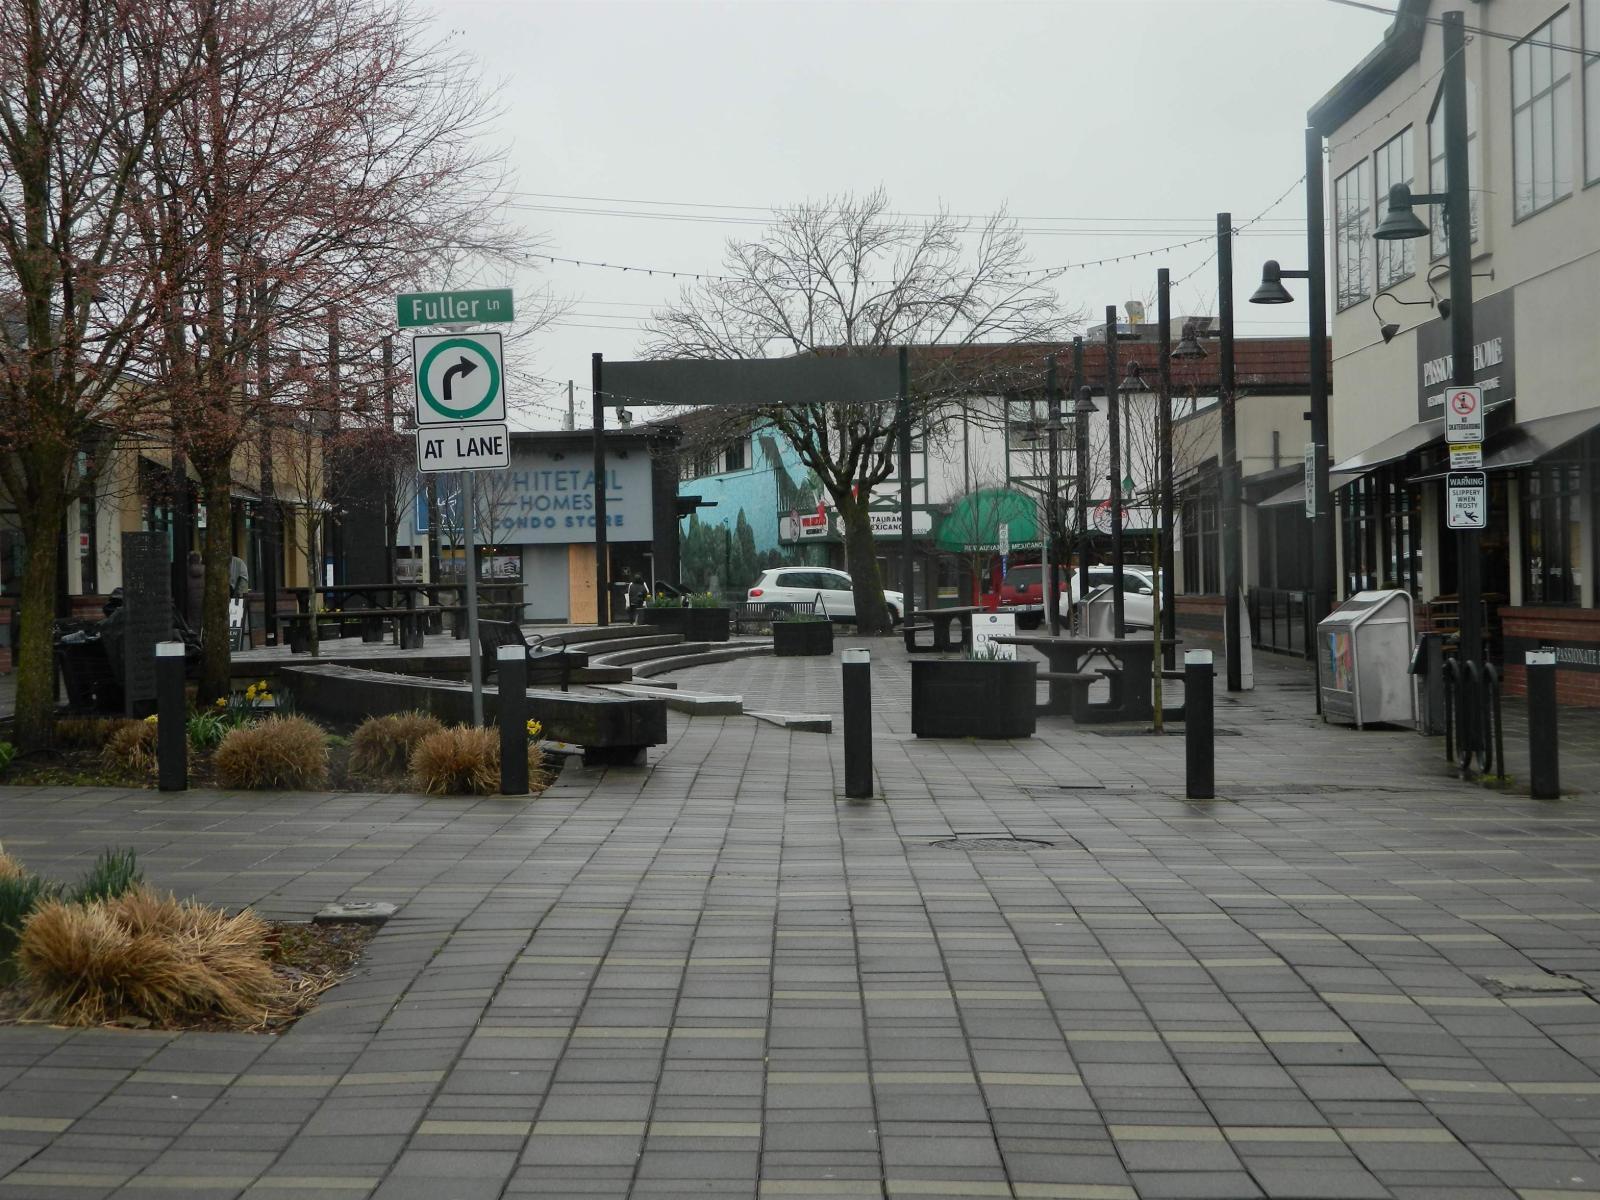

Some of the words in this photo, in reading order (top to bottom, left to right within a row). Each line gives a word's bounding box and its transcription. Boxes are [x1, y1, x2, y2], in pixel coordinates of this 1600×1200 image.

[412, 296, 480, 321] Fuller
[487, 299, 500, 311] Ln
[1473, 337, 1503, 371] HOME
[424, 439, 445, 459] AT
[456, 436, 503, 458] LANE
[1450, 478, 1483, 486] WARNING
[520, 494, 593, 511] HOMES
[493, 515, 556, 529] CONDO
[565, 514, 624, 527] STORE
[1556, 647, 1597, 665] PASSIONATE
